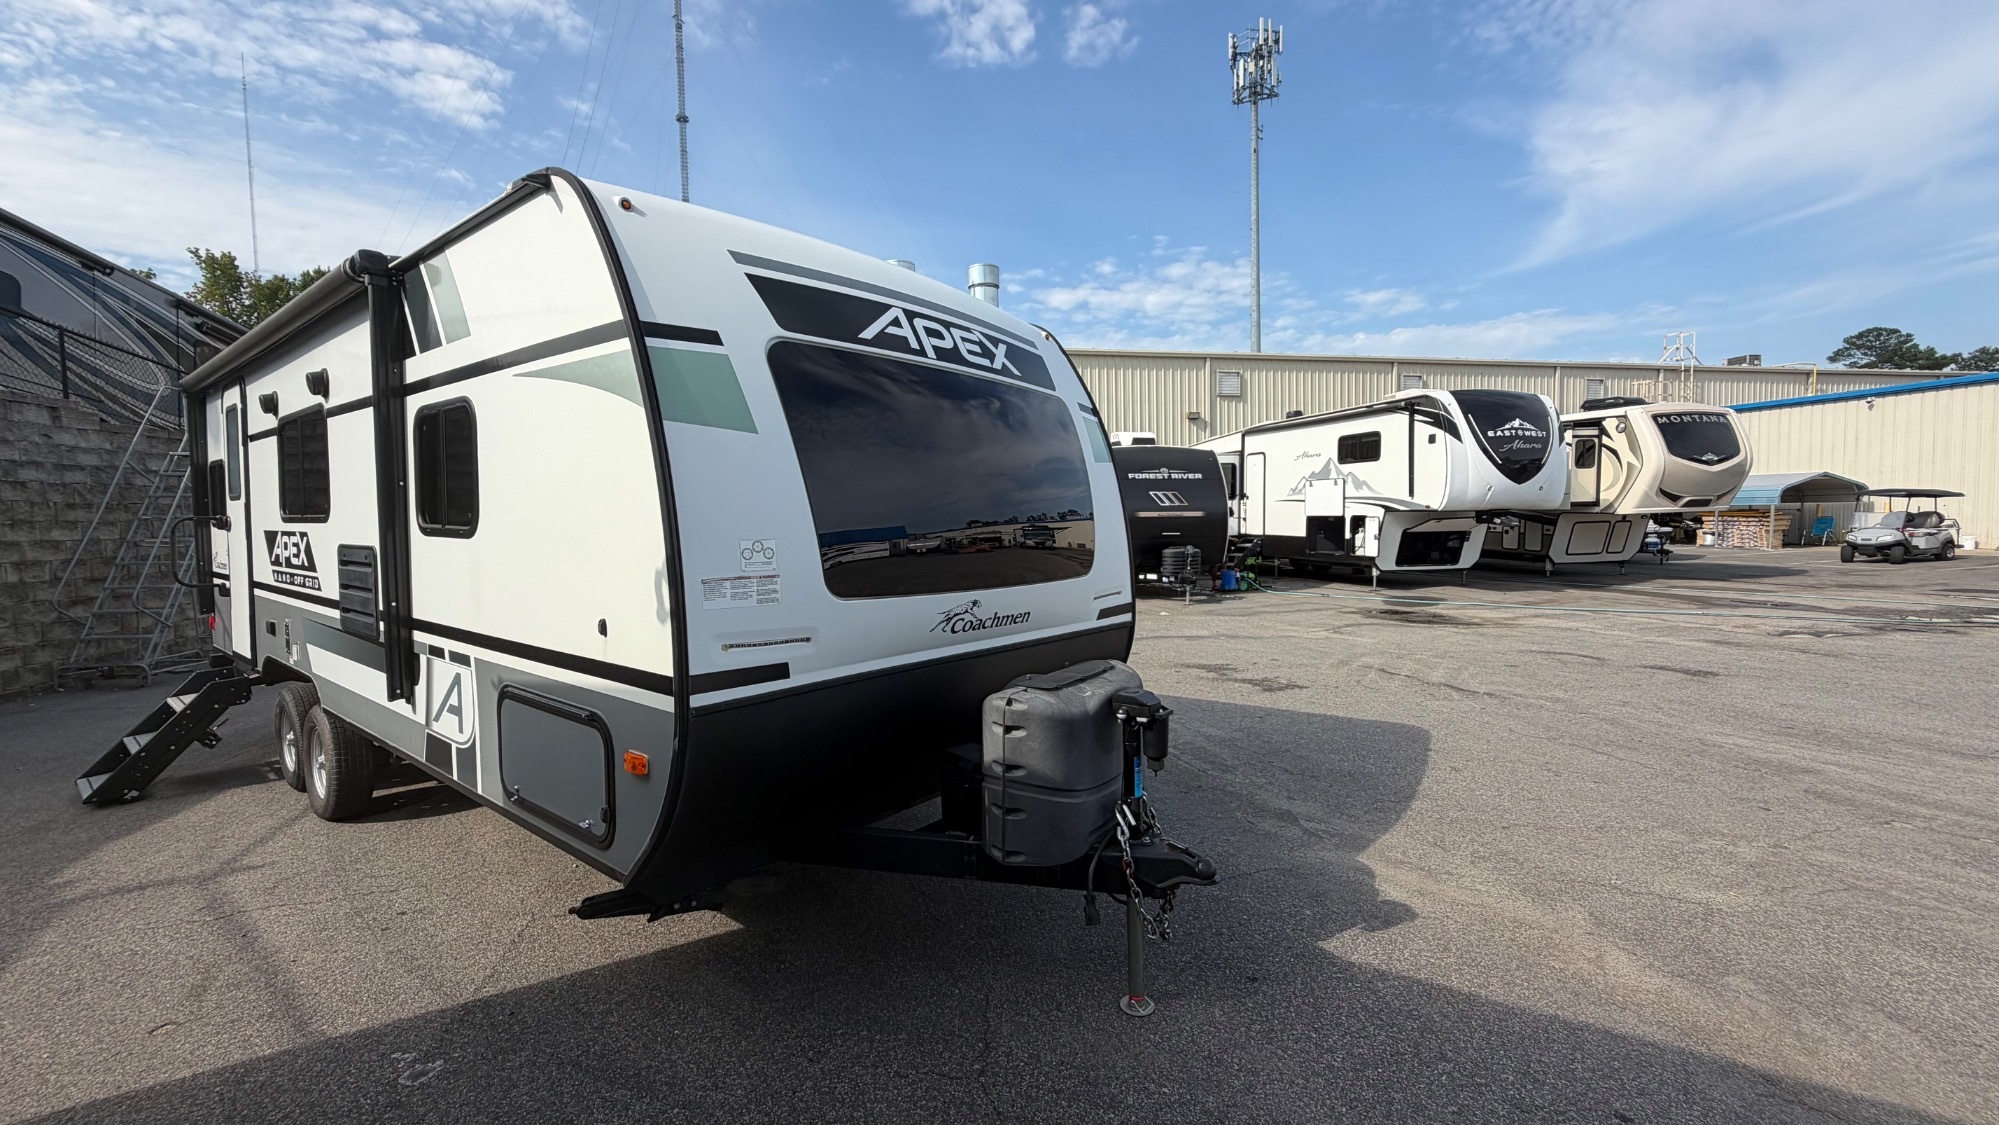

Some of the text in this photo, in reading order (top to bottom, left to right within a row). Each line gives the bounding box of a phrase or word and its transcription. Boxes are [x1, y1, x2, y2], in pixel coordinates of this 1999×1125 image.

[858, 306, 1022, 376] APEX
[1656, 414, 1728, 424] MONTANA
[271, 531, 309, 568] APEX
[950, 611, 1031, 634] Coachmen
